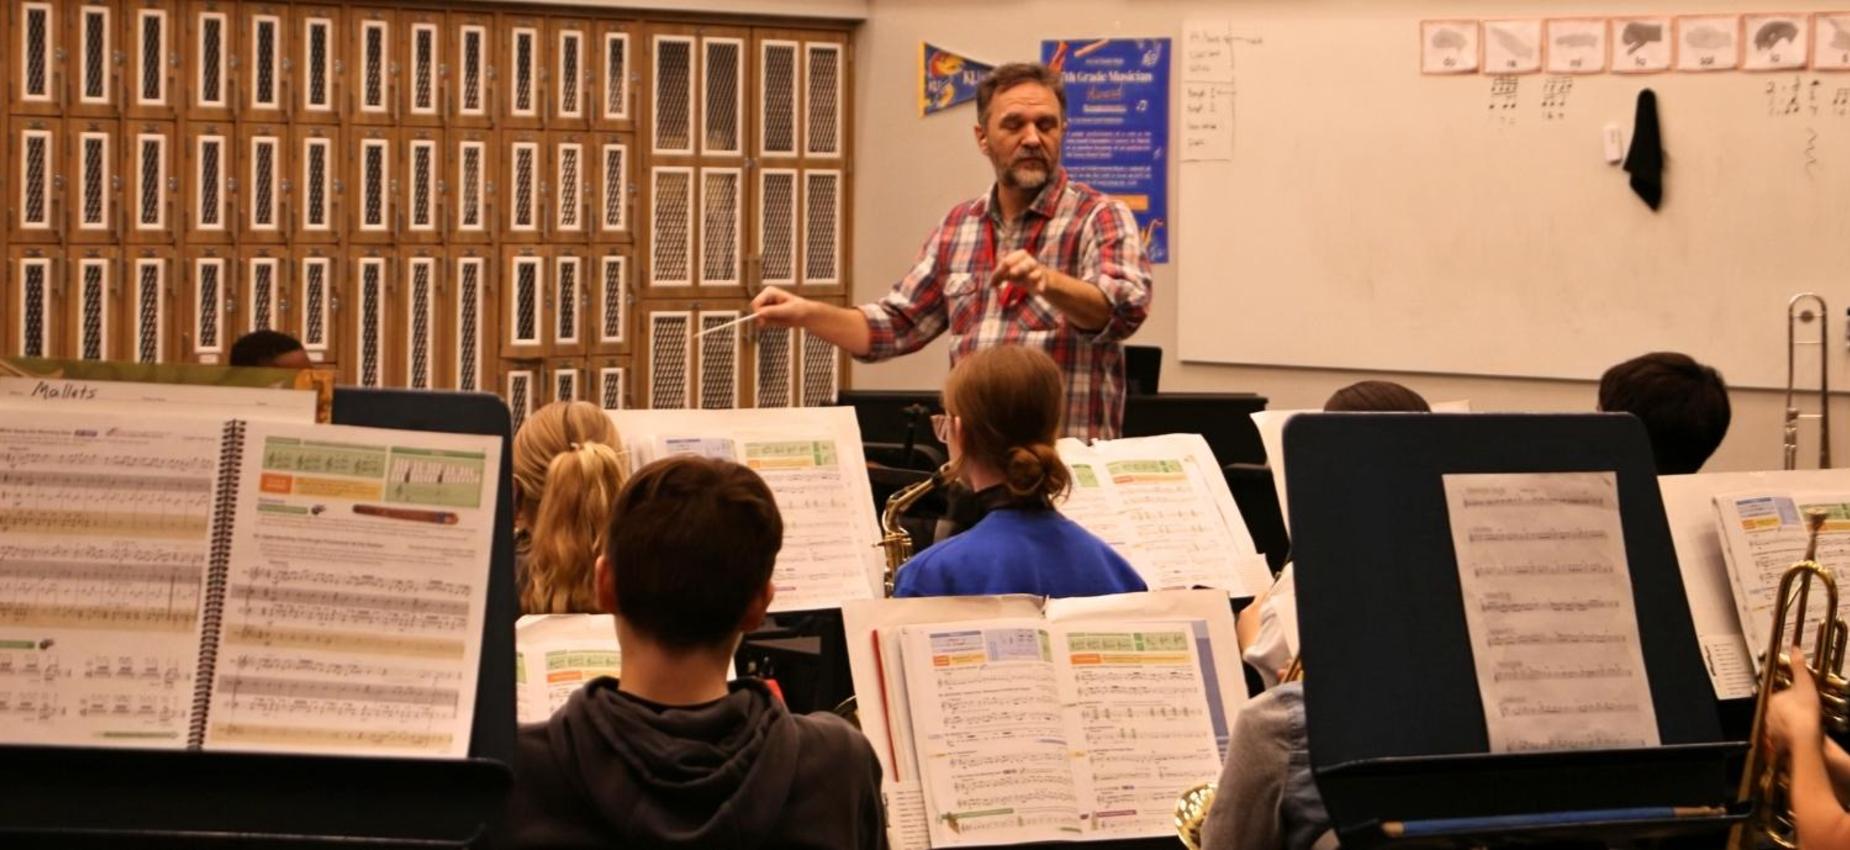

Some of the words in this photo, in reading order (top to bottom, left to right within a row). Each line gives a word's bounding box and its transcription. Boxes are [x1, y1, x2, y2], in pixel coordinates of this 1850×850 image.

[1077, 70, 1106, 83] Grade
[1108, 69, 1153, 83] Musician
[31, 380, 97, 400] Mallets
